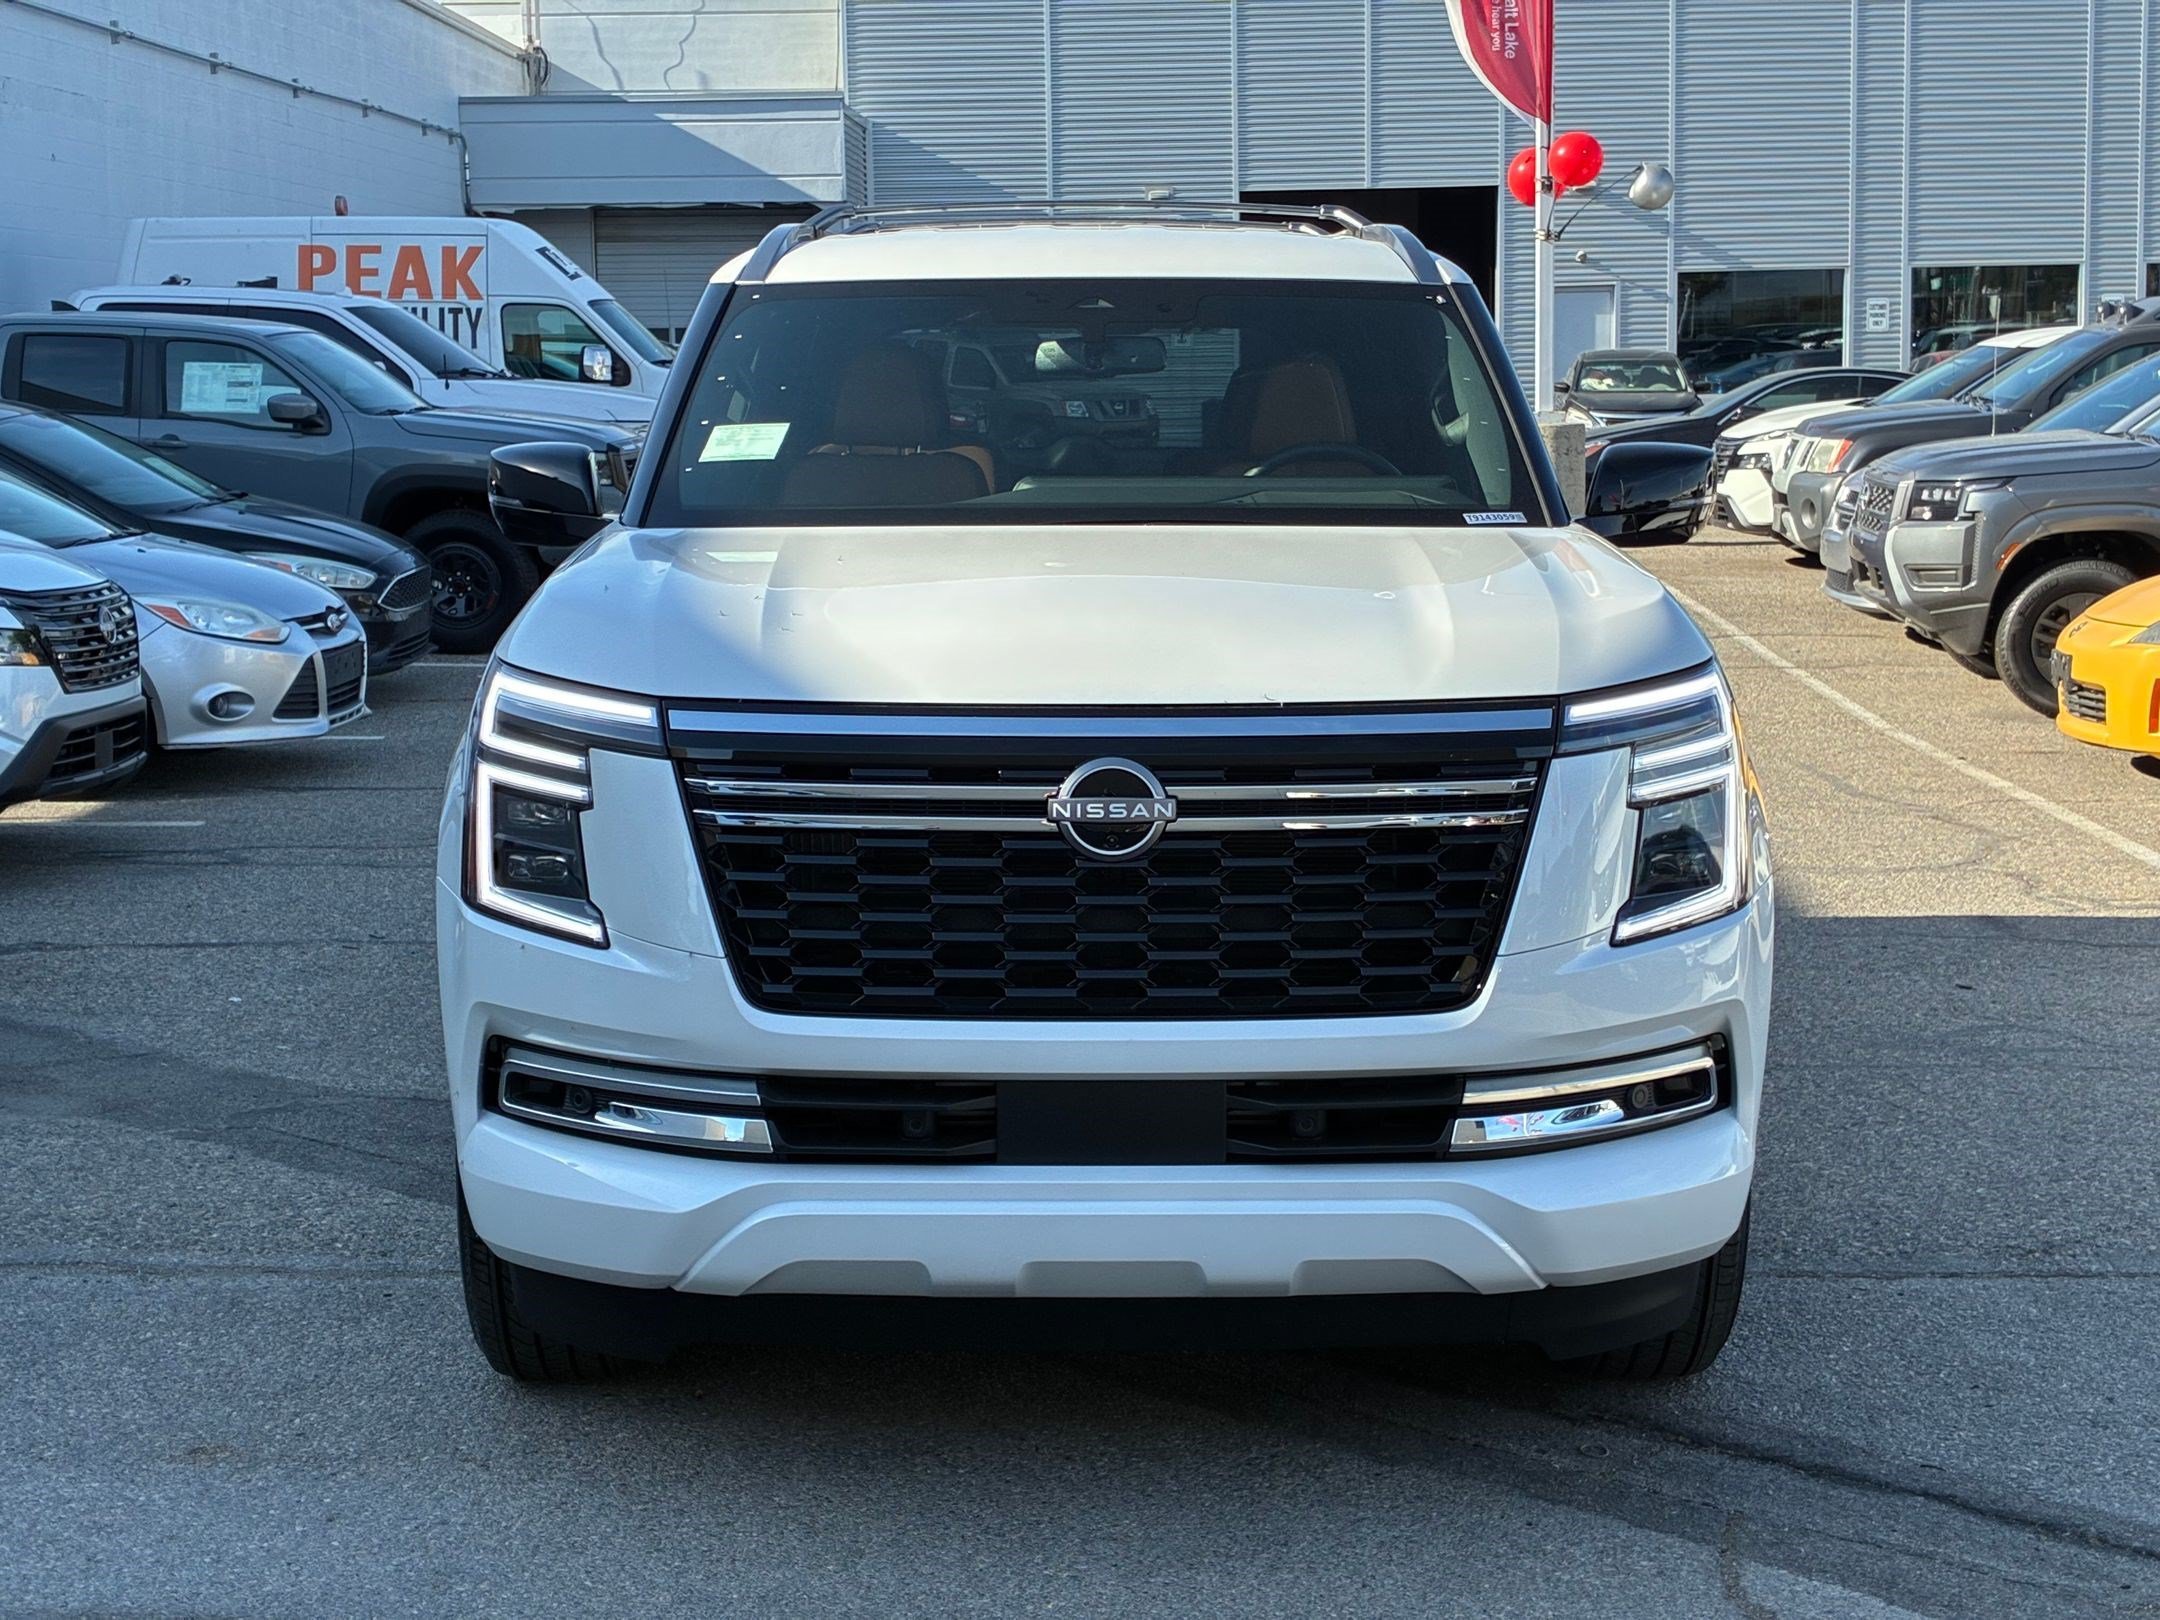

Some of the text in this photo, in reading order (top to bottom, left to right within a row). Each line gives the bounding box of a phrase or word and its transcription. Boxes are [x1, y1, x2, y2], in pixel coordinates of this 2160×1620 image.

[1491, 6, 1502, 29] hear
[1490, 31, 1501, 51] you
[1504, 22, 1520, 59] Lake
[297, 244, 485, 301] PEAK
[1052, 802, 1173, 818] NISSAN
